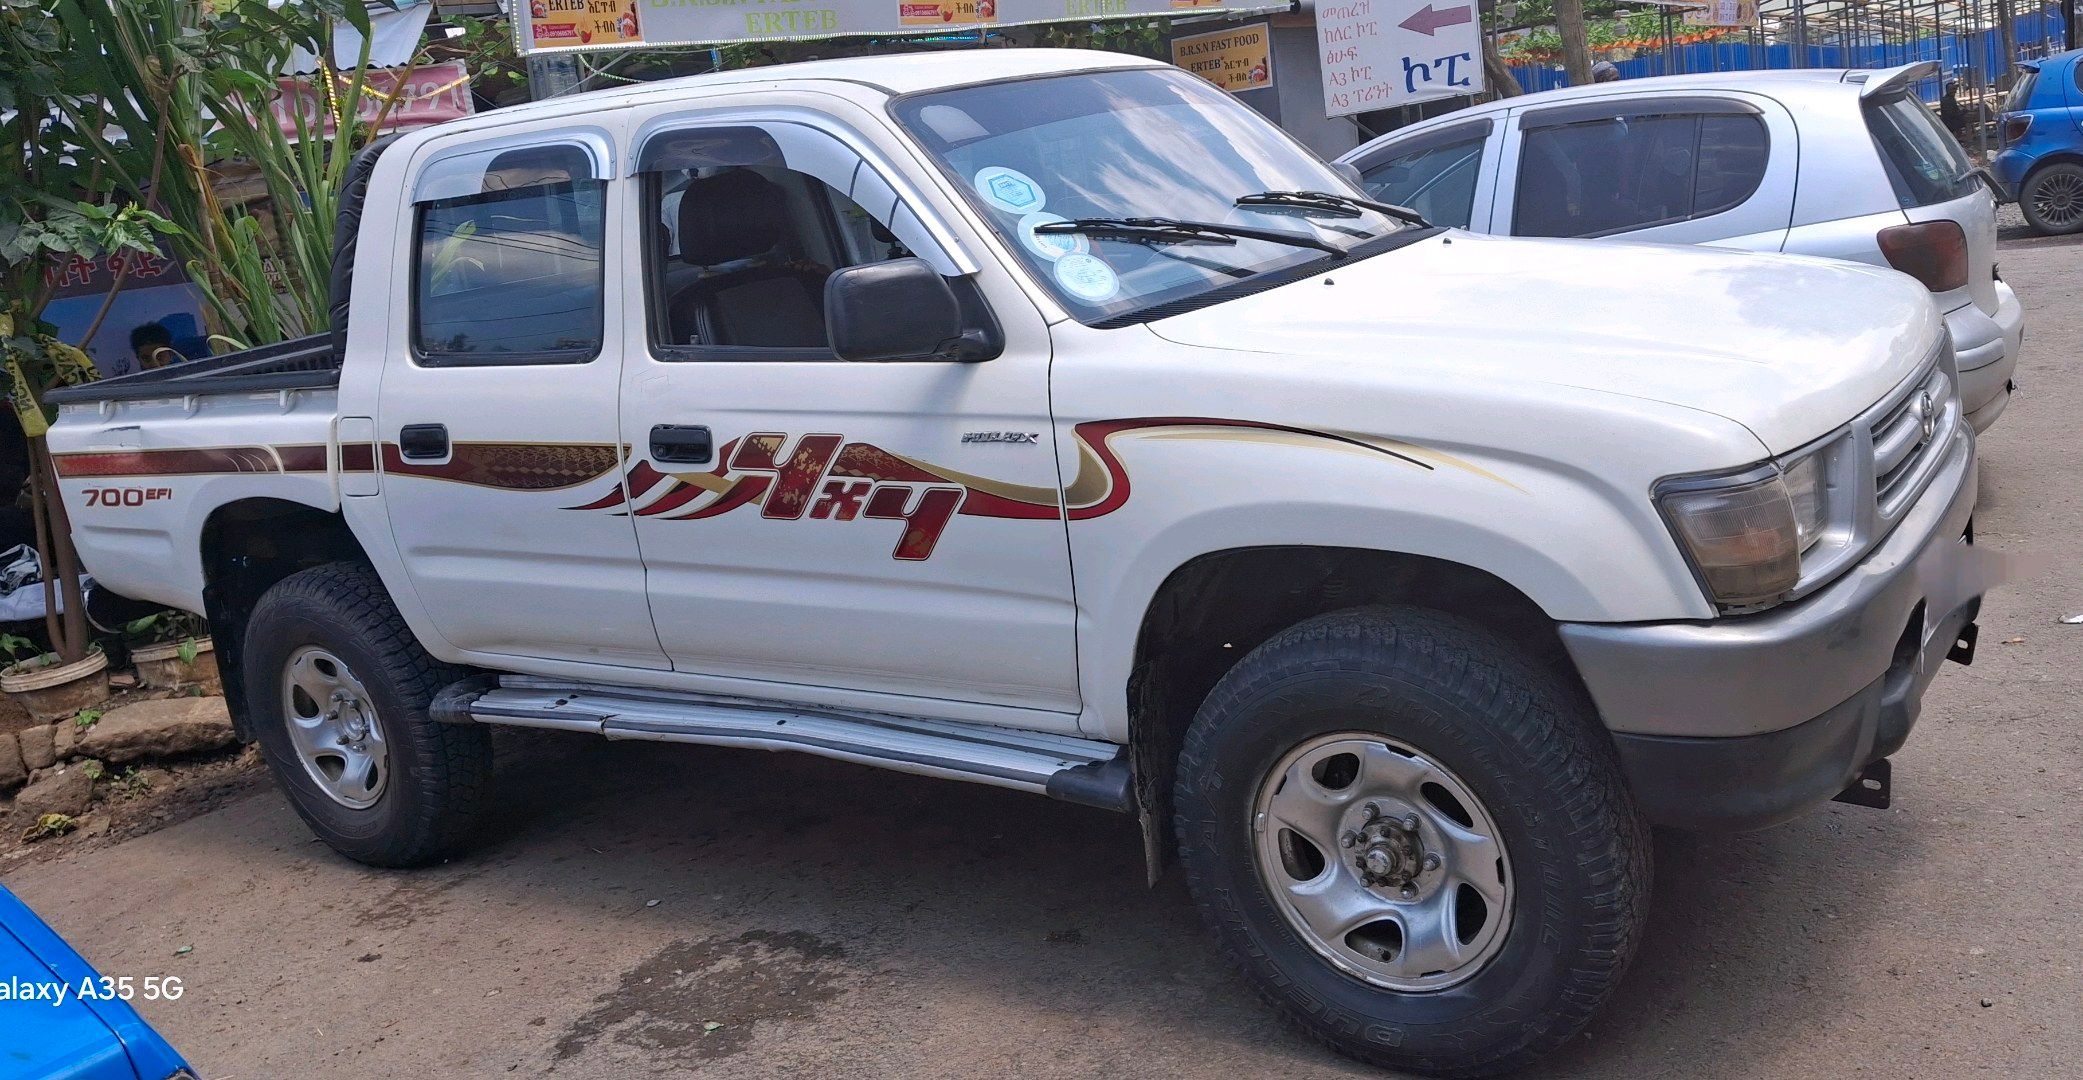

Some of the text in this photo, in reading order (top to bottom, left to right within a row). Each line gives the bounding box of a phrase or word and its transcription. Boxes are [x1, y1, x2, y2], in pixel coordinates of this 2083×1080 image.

[745, 10, 839, 33] ERTEB
[1356, 21, 1377, 38] ኮፒ
[1211, 38, 1231, 51] FAST
[1234, 33, 1259, 47] FOOD
[1190, 59, 1220, 73] ERTEB
[1401, 52, 1471, 93] ኮፒ
[1329, 65, 1372, 87] A3 ኮፒ
[1331, 93, 1349, 108] A3
[82, 488, 172, 507] 700 EFI
